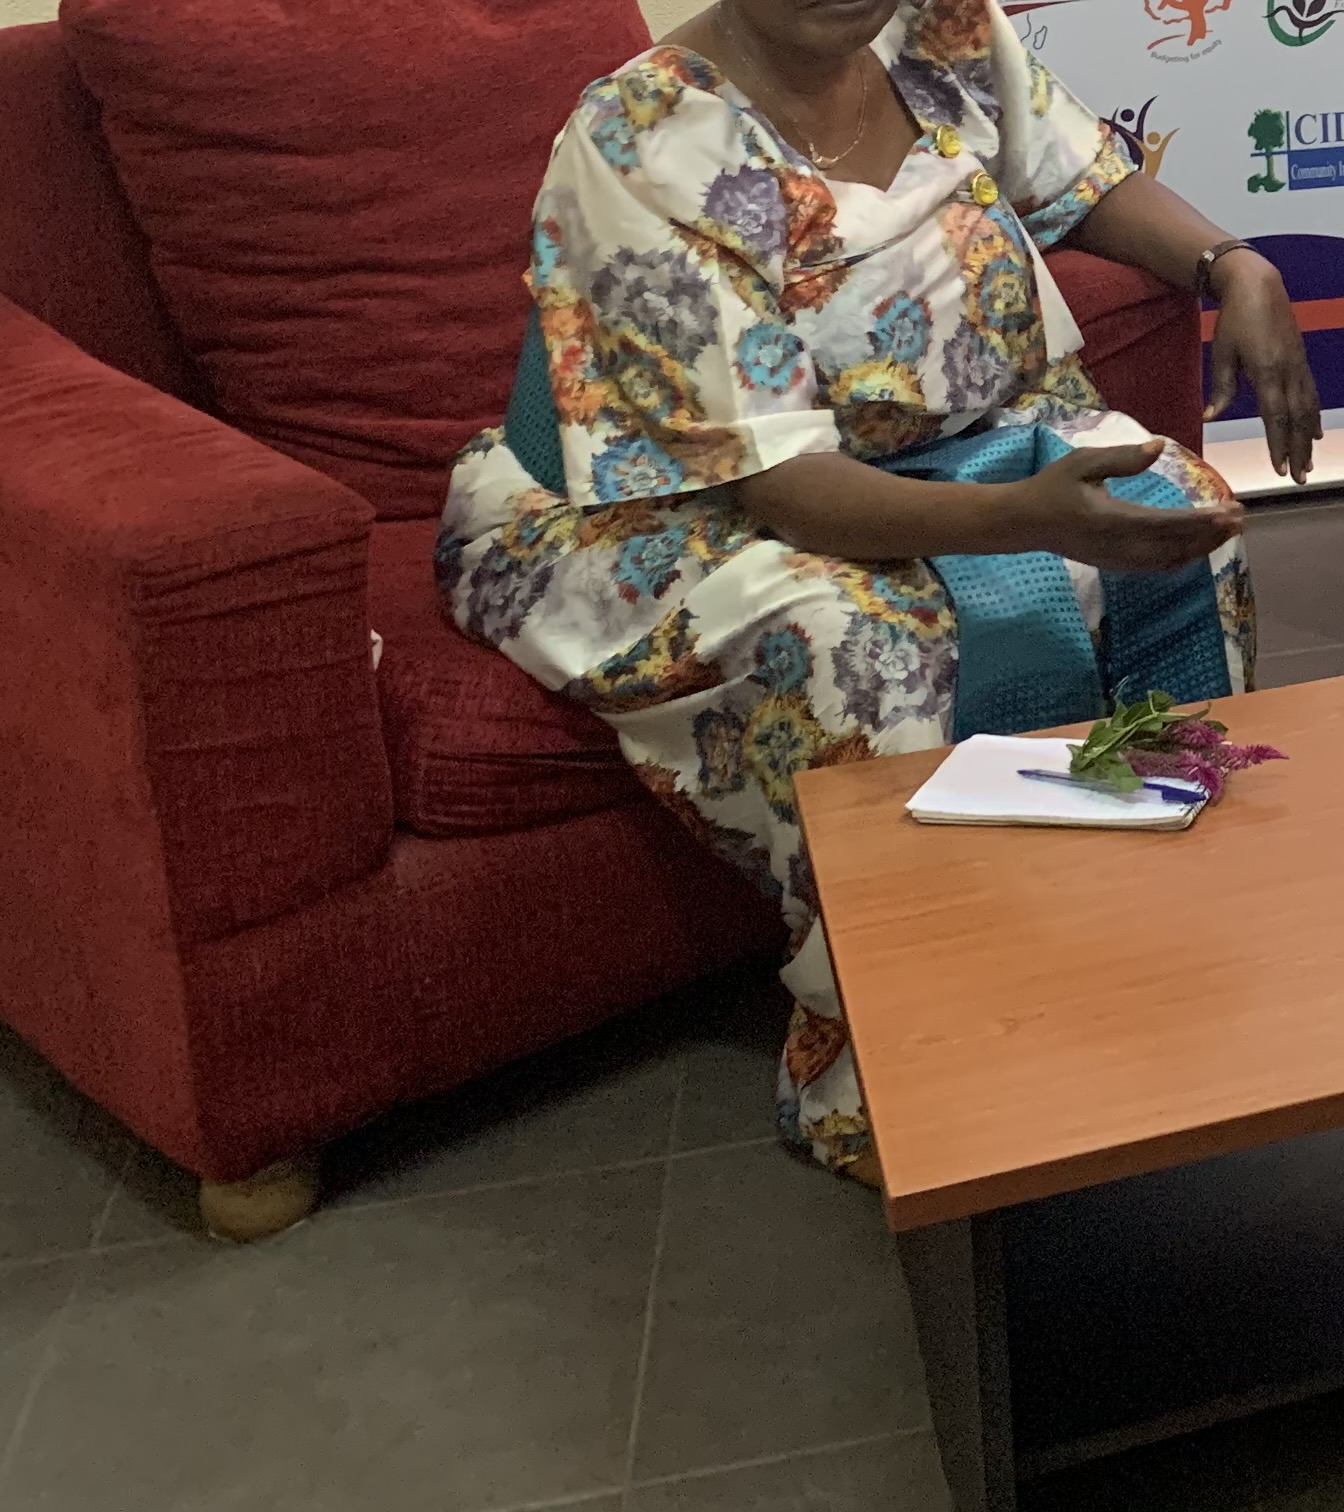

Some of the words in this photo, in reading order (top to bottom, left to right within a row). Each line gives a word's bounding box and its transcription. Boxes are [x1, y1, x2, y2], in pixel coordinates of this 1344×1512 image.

[1150, 51, 1190, 63] Budgeting
[1190, 52, 1200, 61] for
[1202, 39, 1222, 56] equity
[1291, 161, 1337, 181] Community
